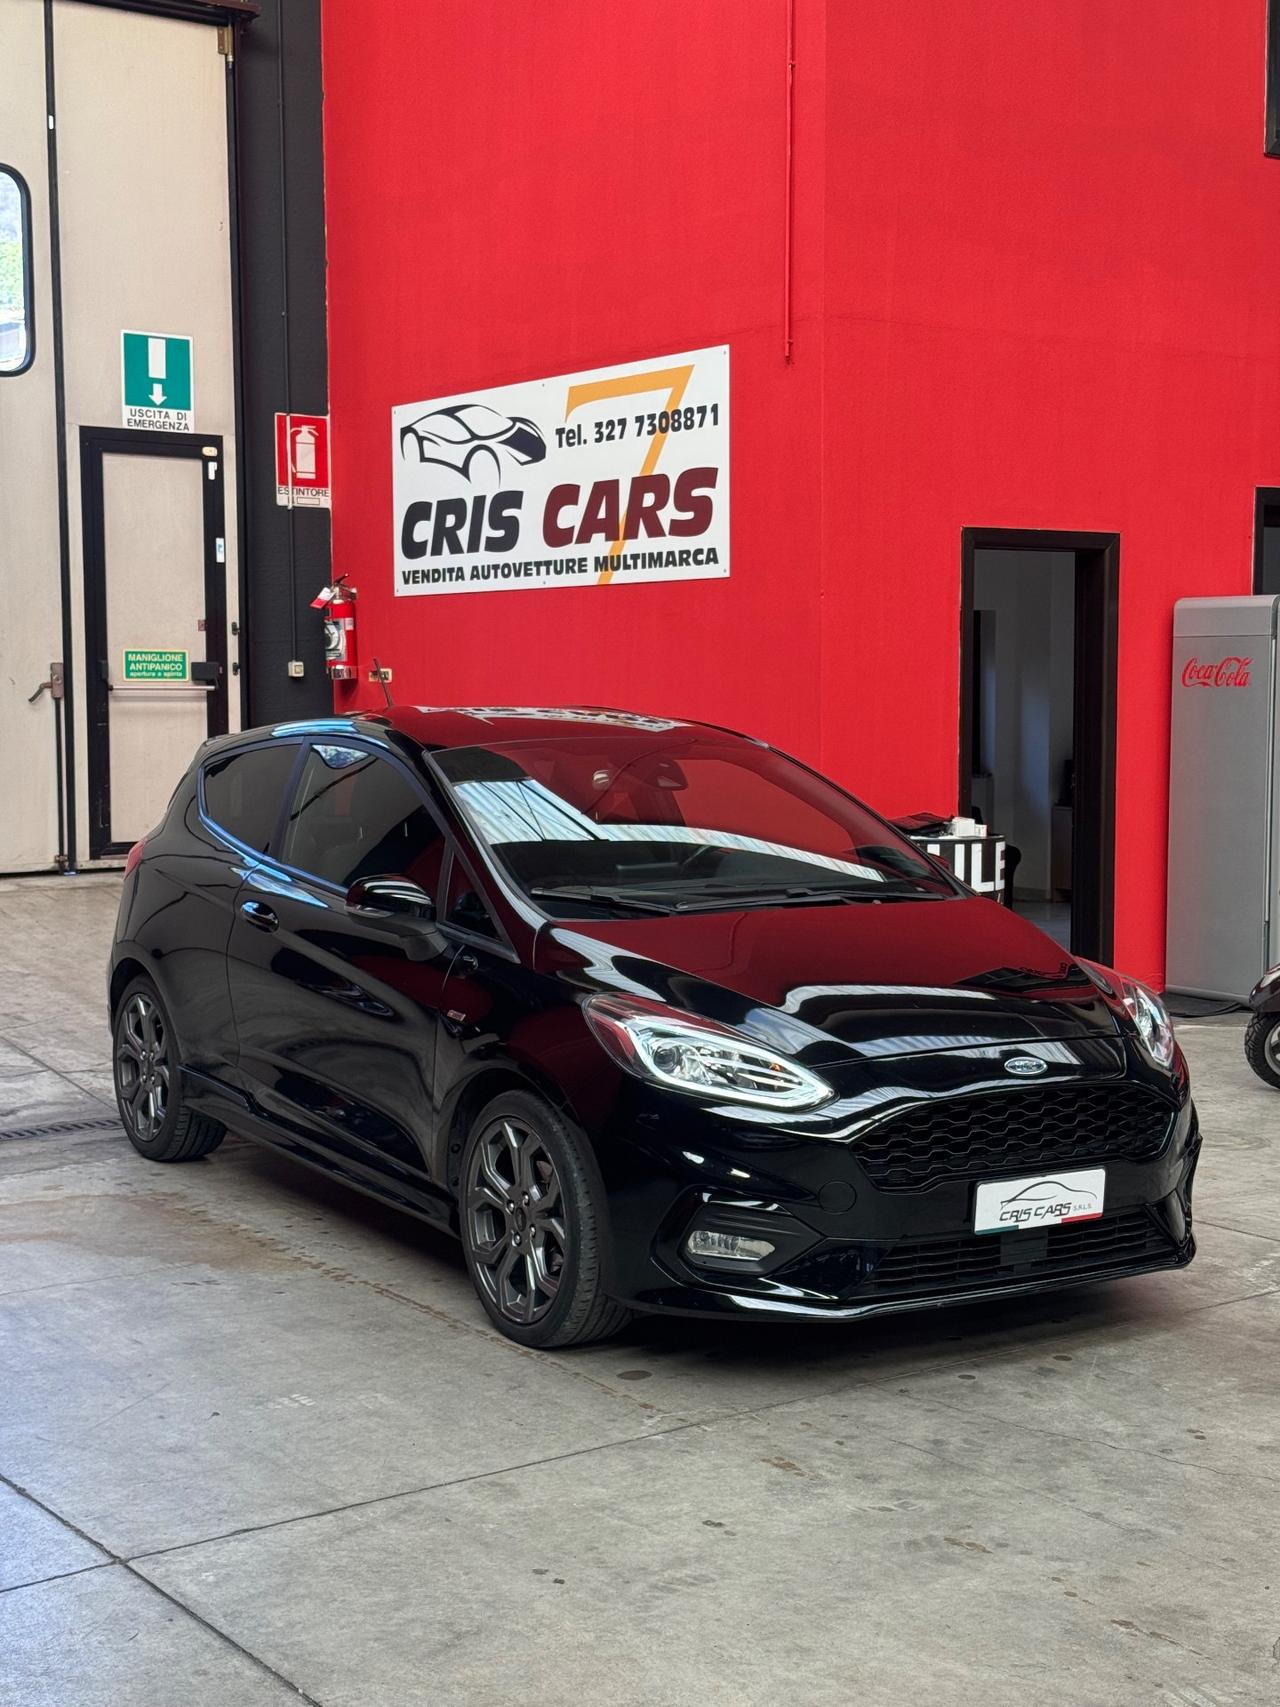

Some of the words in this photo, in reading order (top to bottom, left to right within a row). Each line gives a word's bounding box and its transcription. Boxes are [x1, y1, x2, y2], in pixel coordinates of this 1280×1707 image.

[130, 408, 170, 419] USCITA
[176, 412, 187, 421] DI
[127, 418, 190, 432] EMERGENZA
[555, 423, 588, 448] Tel.
[594, 417, 627, 443] 327
[635, 403, 719, 437] 7308871
[401, 490, 524, 560] CRIS
[543, 466, 718, 548] CARS
[402, 566, 465, 585] VENDITA
[470, 557, 588, 581] AUTOVETTURE
[594, 547, 719, 573] MULTIMARCA
[128, 653, 184, 662] MANIGLIONE
[130, 662, 182, 671] ANTIPANICO
[999, 1207, 1032, 1223] CRIS
[1034, 1202, 1072, 1219] CARS
